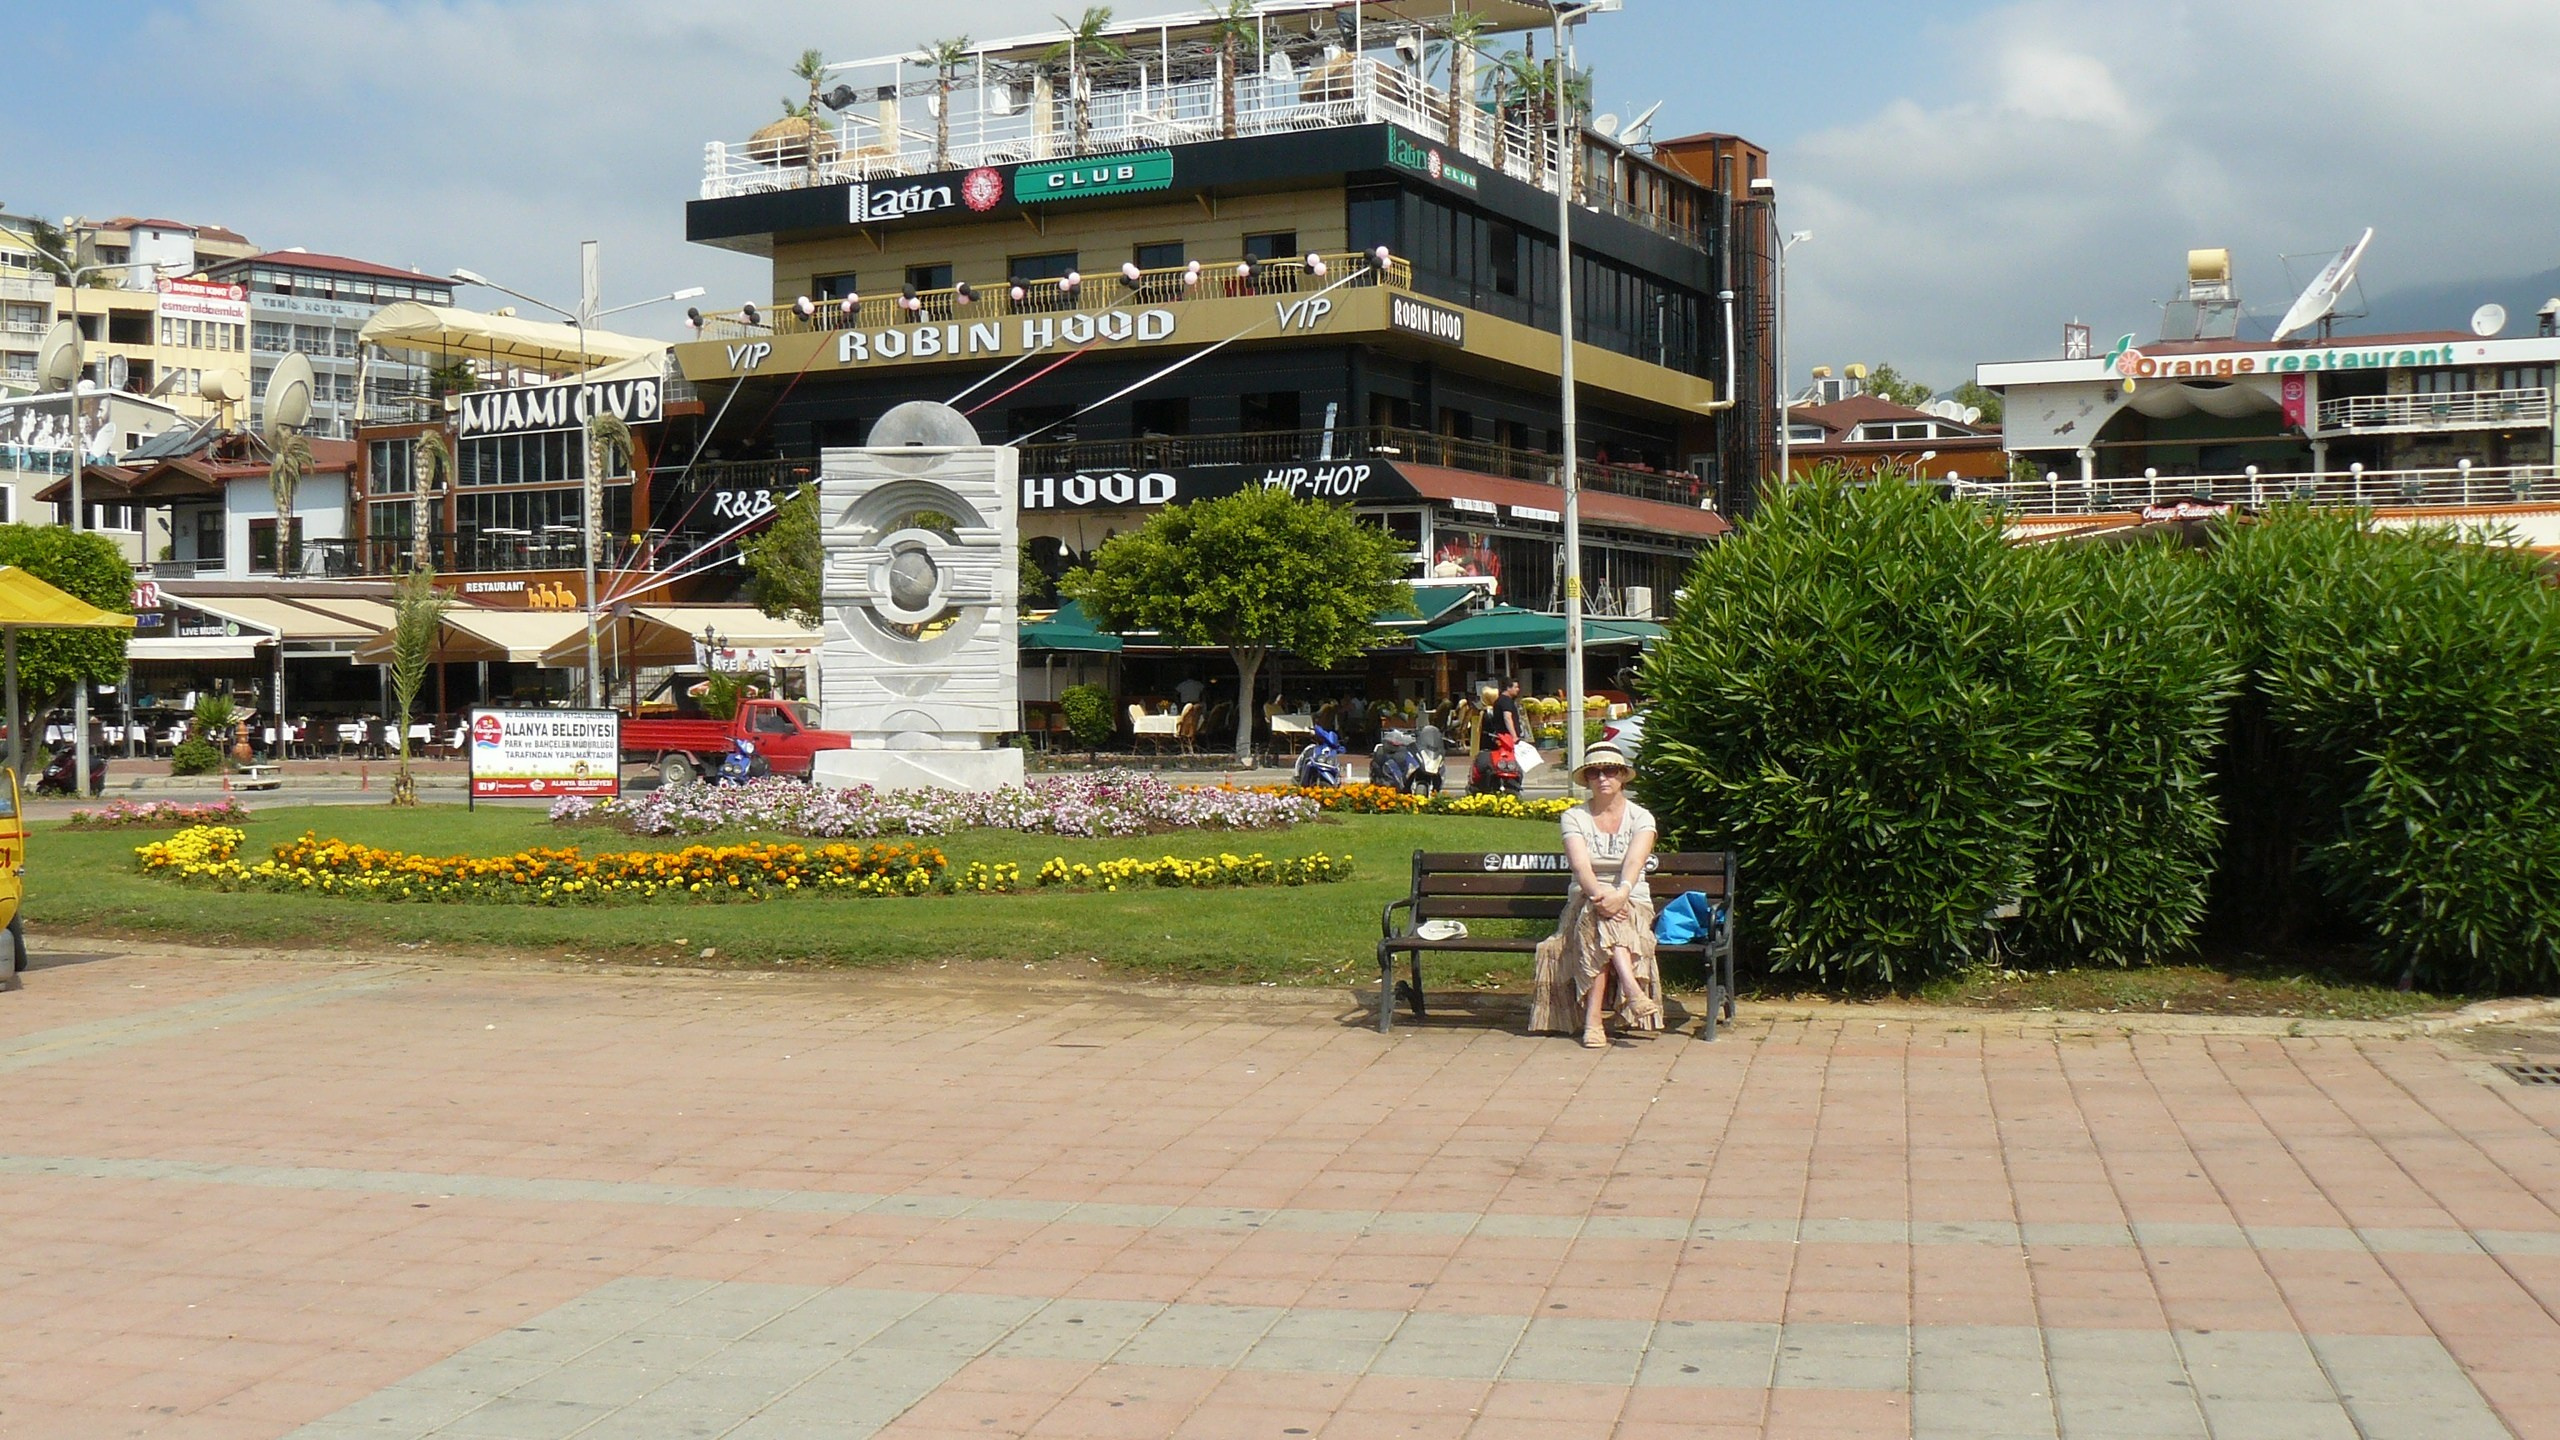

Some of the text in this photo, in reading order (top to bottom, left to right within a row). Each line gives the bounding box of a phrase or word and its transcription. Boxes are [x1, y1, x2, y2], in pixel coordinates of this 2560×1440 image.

[1443, 166, 1477, 187] CLUB
[849, 165, 1135, 223] Latin CLUB
[173, 282, 228, 297] BURGER KING
[1276, 298, 1333, 331] VIP
[1394, 298, 1461, 341] ROBIN HOOD
[838, 308, 1176, 364] ROBIN HOOD
[727, 341, 772, 371] VIP
[2136, 343, 2455, 378] Orange restaurant
[462, 380, 657, 434] MIAMI CLUB
[1023, 472, 1177, 509] HOOD
[1262, 464, 1371, 498] HIP-HOP
[713, 490, 774, 520] R&B
[466, 581, 525, 593] RESTAURANT
[181, 626, 224, 636] LIVE MUSIC
[504, 722, 549, 737] ALANYA
[504, 740, 523, 749] PARK
[534, 740, 571, 750] BAHÇELER
[505, 751, 553, 759] TARAFINDAN
[1501, 854, 1557, 870] ALANYA
